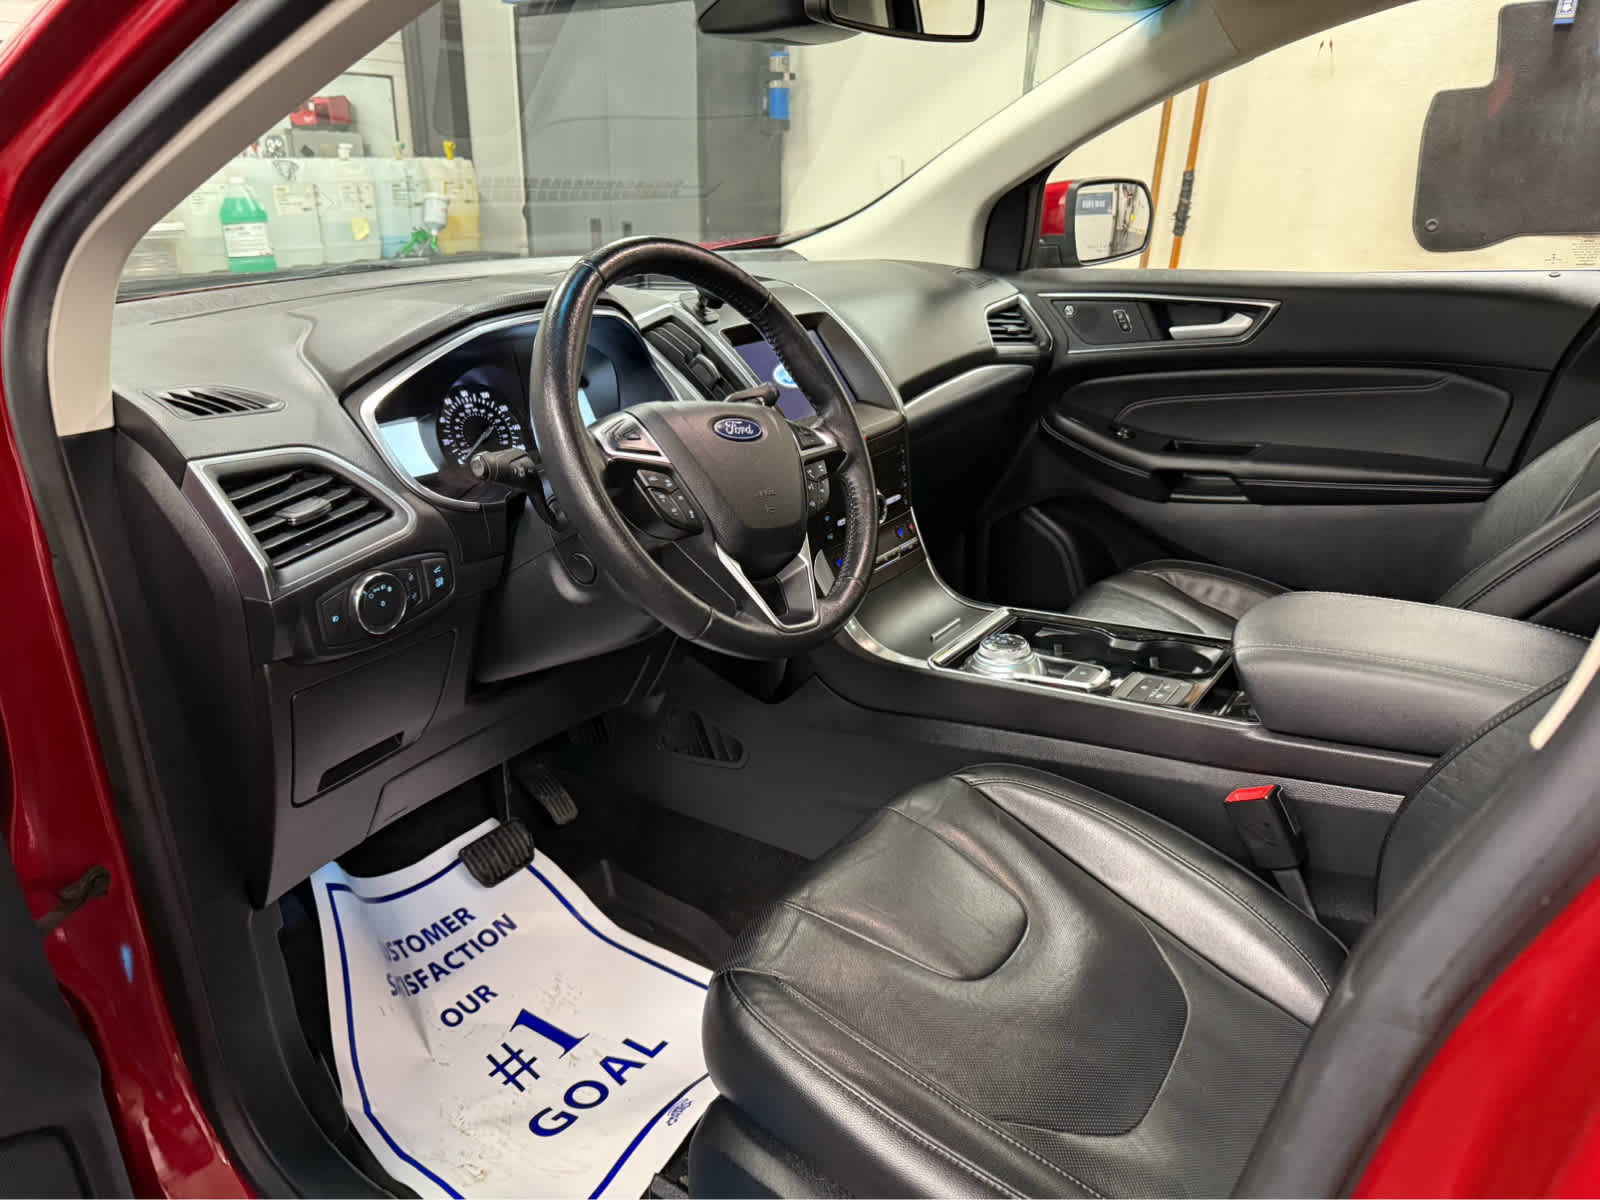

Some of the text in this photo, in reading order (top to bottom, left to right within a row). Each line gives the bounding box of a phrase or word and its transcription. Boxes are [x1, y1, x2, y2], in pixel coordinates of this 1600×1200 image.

[716, 419, 758, 436] Ford
[384, 907, 477, 962] STOMER
[440, 985, 499, 1027] OUR
[486, 1008, 590, 1092] #1
[529, 1038, 669, 1137] GOAL
